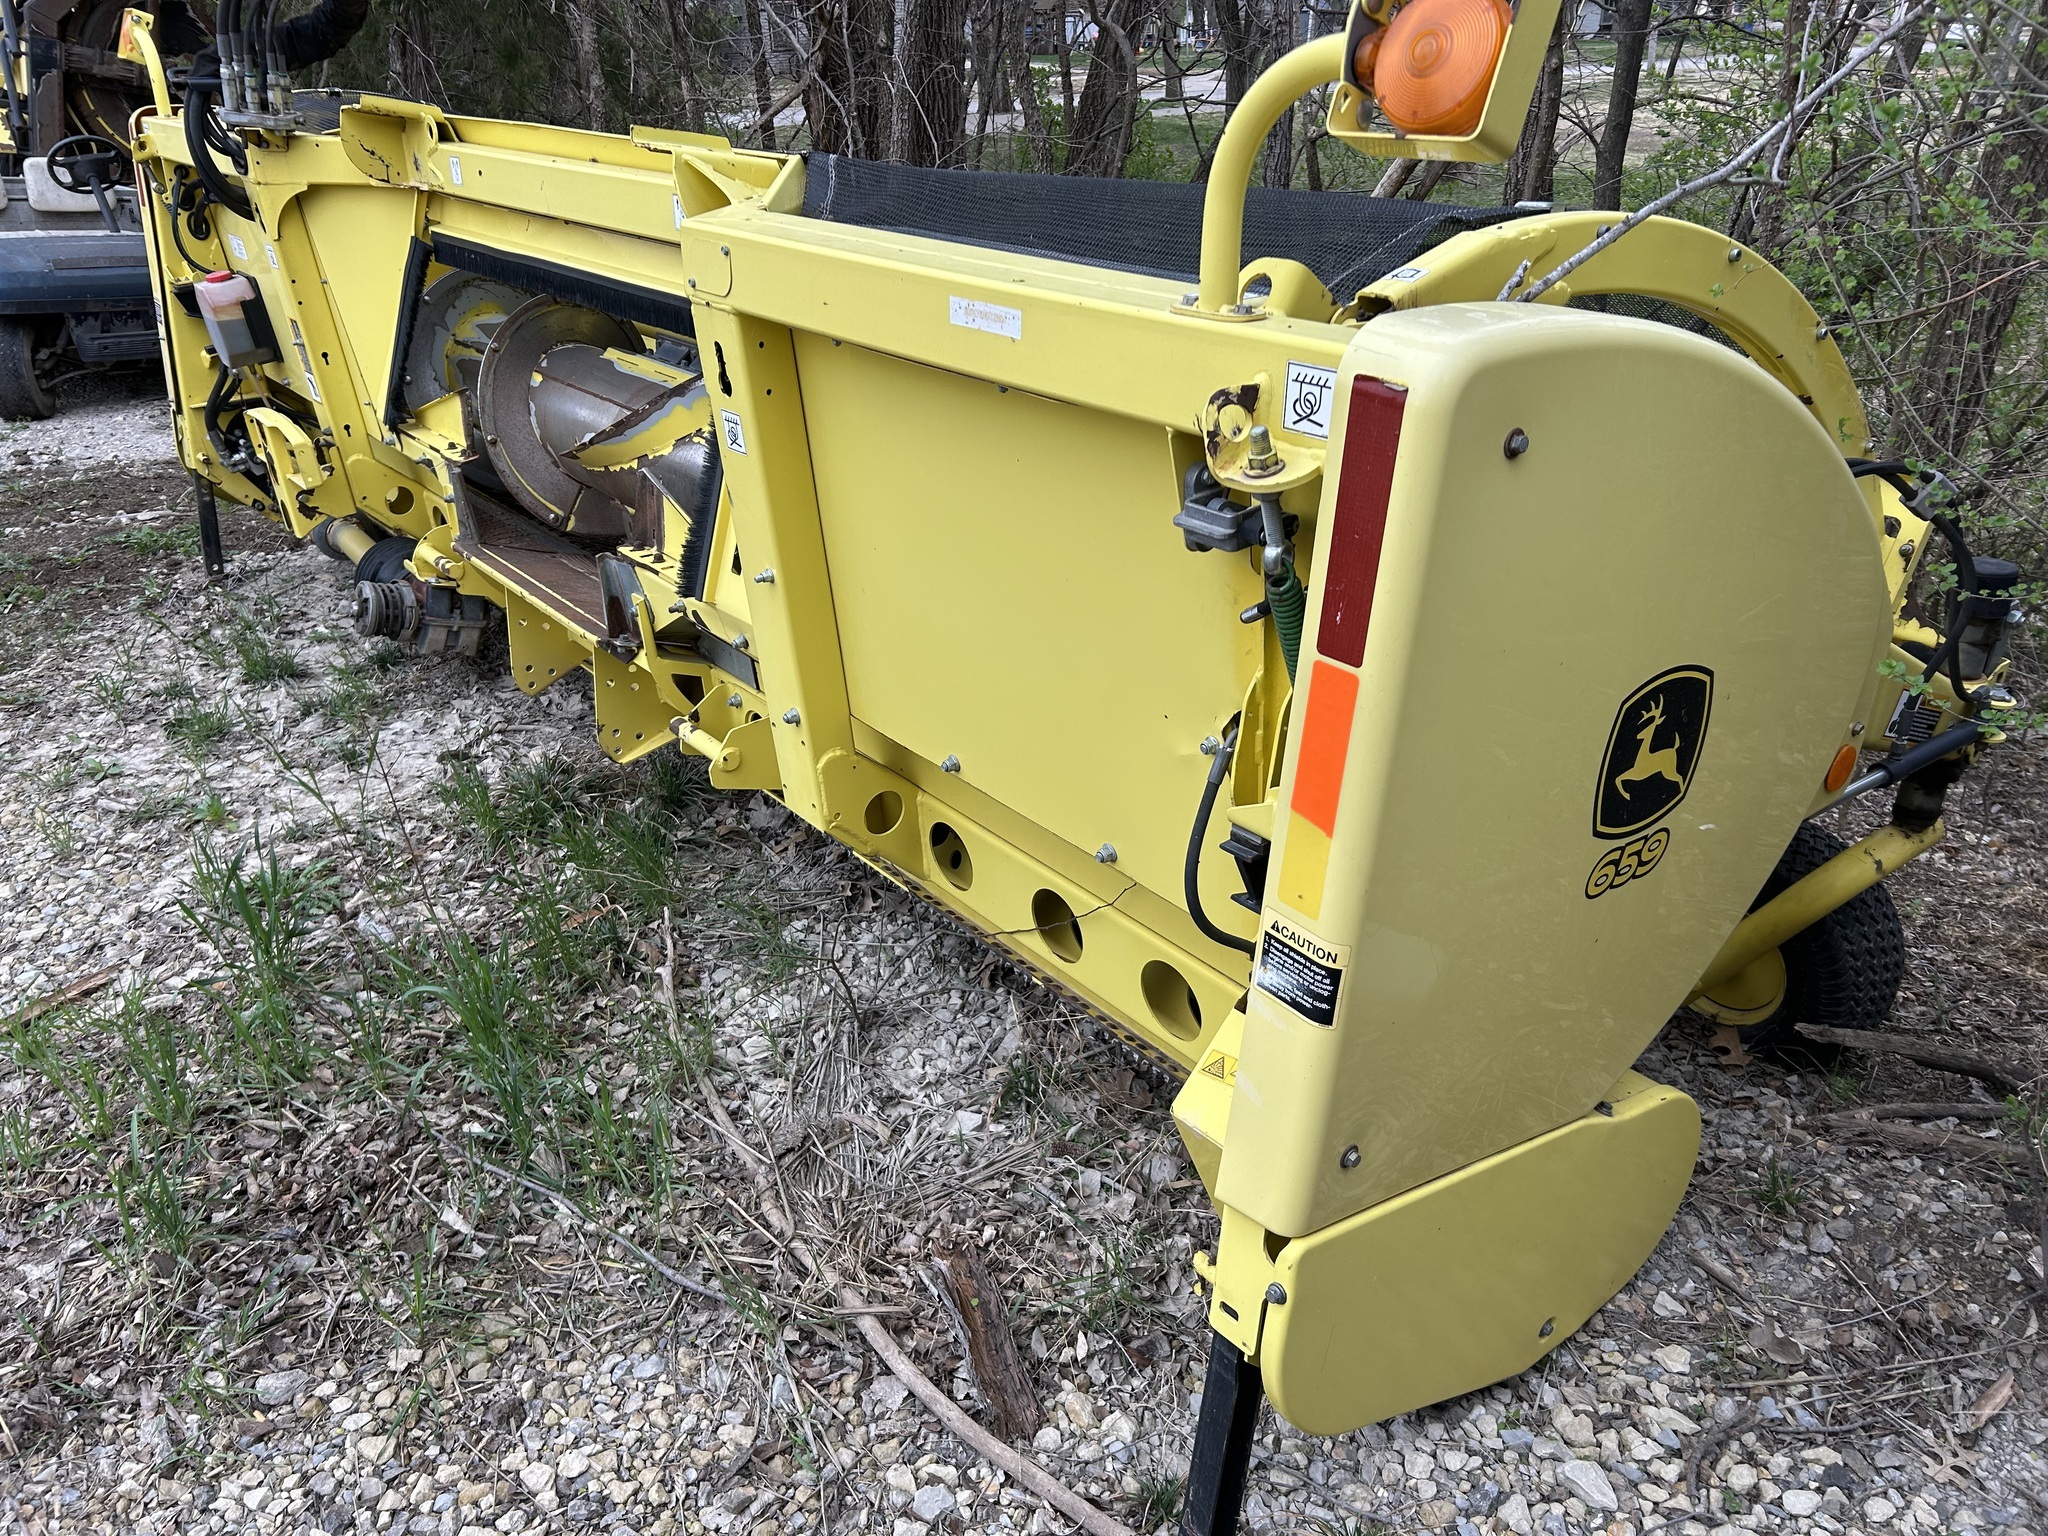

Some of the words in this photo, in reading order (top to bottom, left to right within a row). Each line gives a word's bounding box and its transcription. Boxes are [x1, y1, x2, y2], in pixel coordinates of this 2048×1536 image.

[1585, 827, 1670, 899] 659
[1281, 926, 1338, 964] CAUTION
[1289, 951, 1305, 964] shields
[1293, 962, 1303, 971] and
[1314, 981, 1334, 991] power
[1303, 995, 1312, 1003] and
